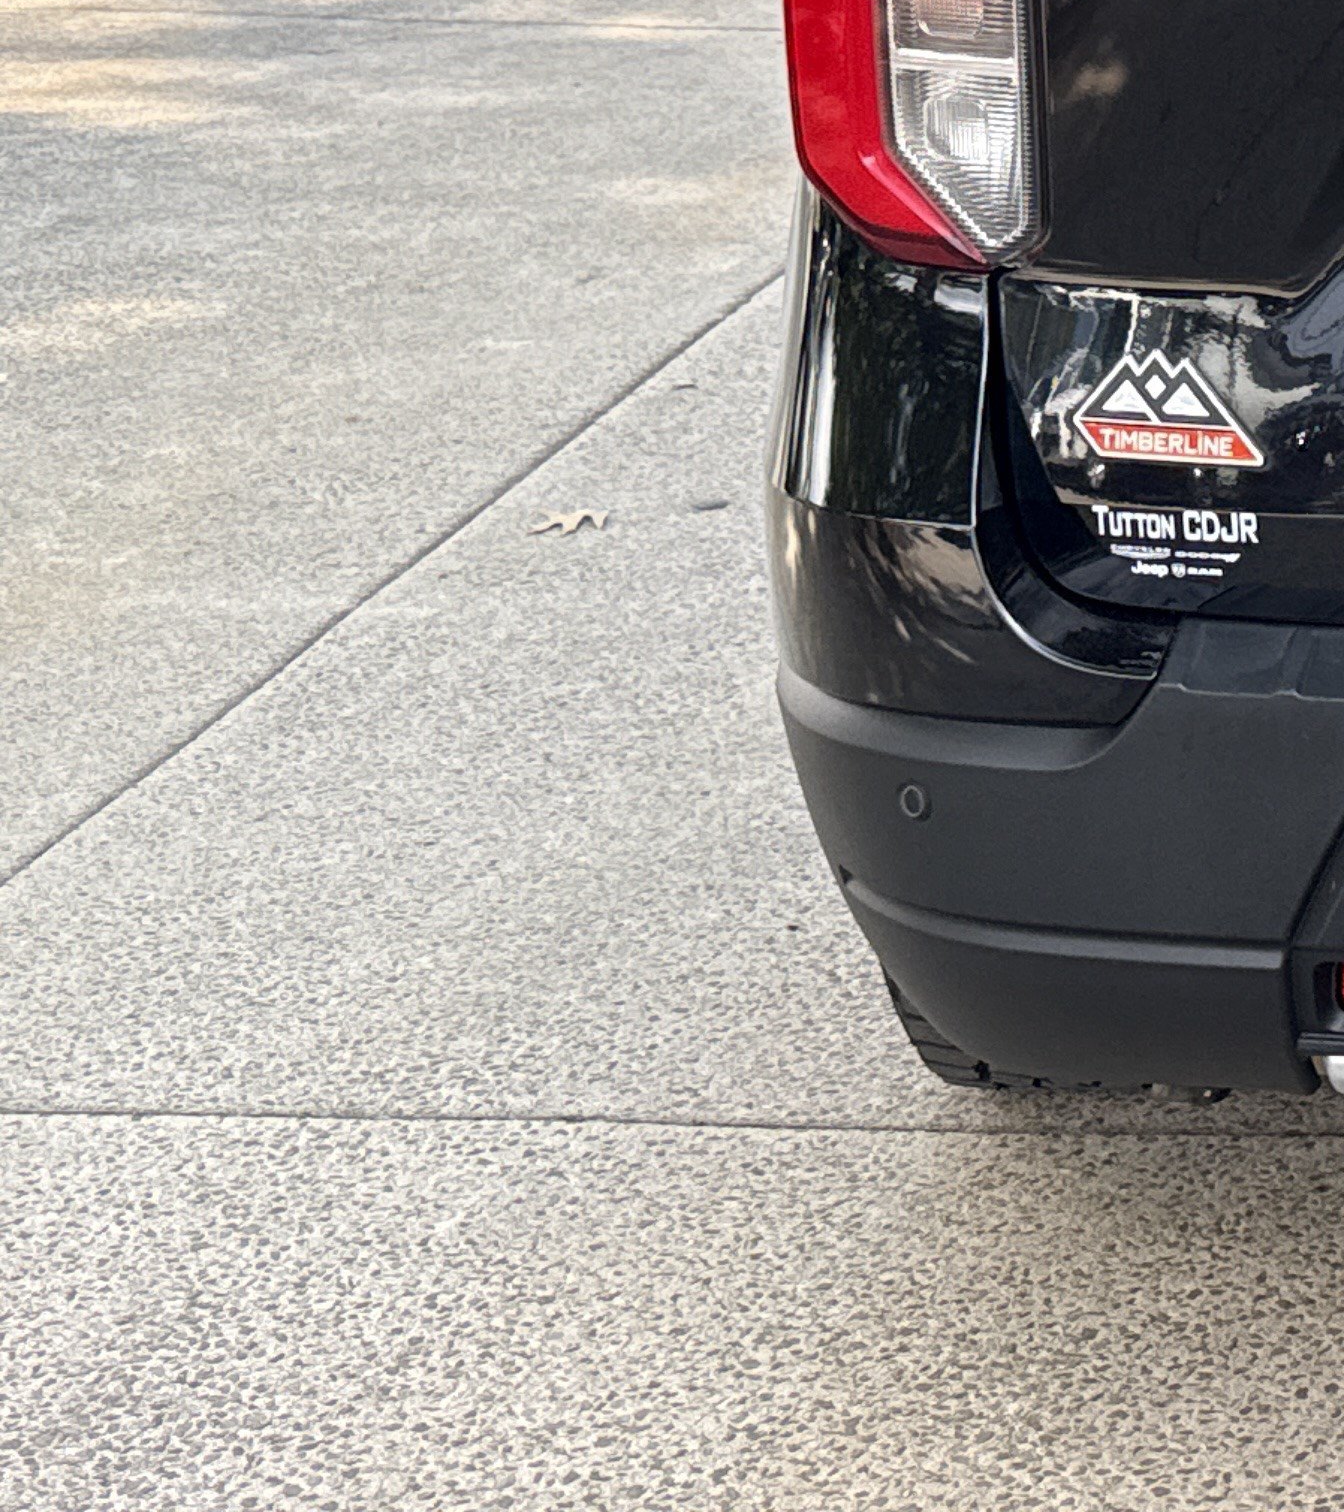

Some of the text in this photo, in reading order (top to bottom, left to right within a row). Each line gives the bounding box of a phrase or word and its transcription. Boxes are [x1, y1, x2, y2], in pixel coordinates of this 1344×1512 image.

[1100, 427, 1234, 457] TIMBERLINE
[1091, 504, 1260, 544] TUTTON CDJR
